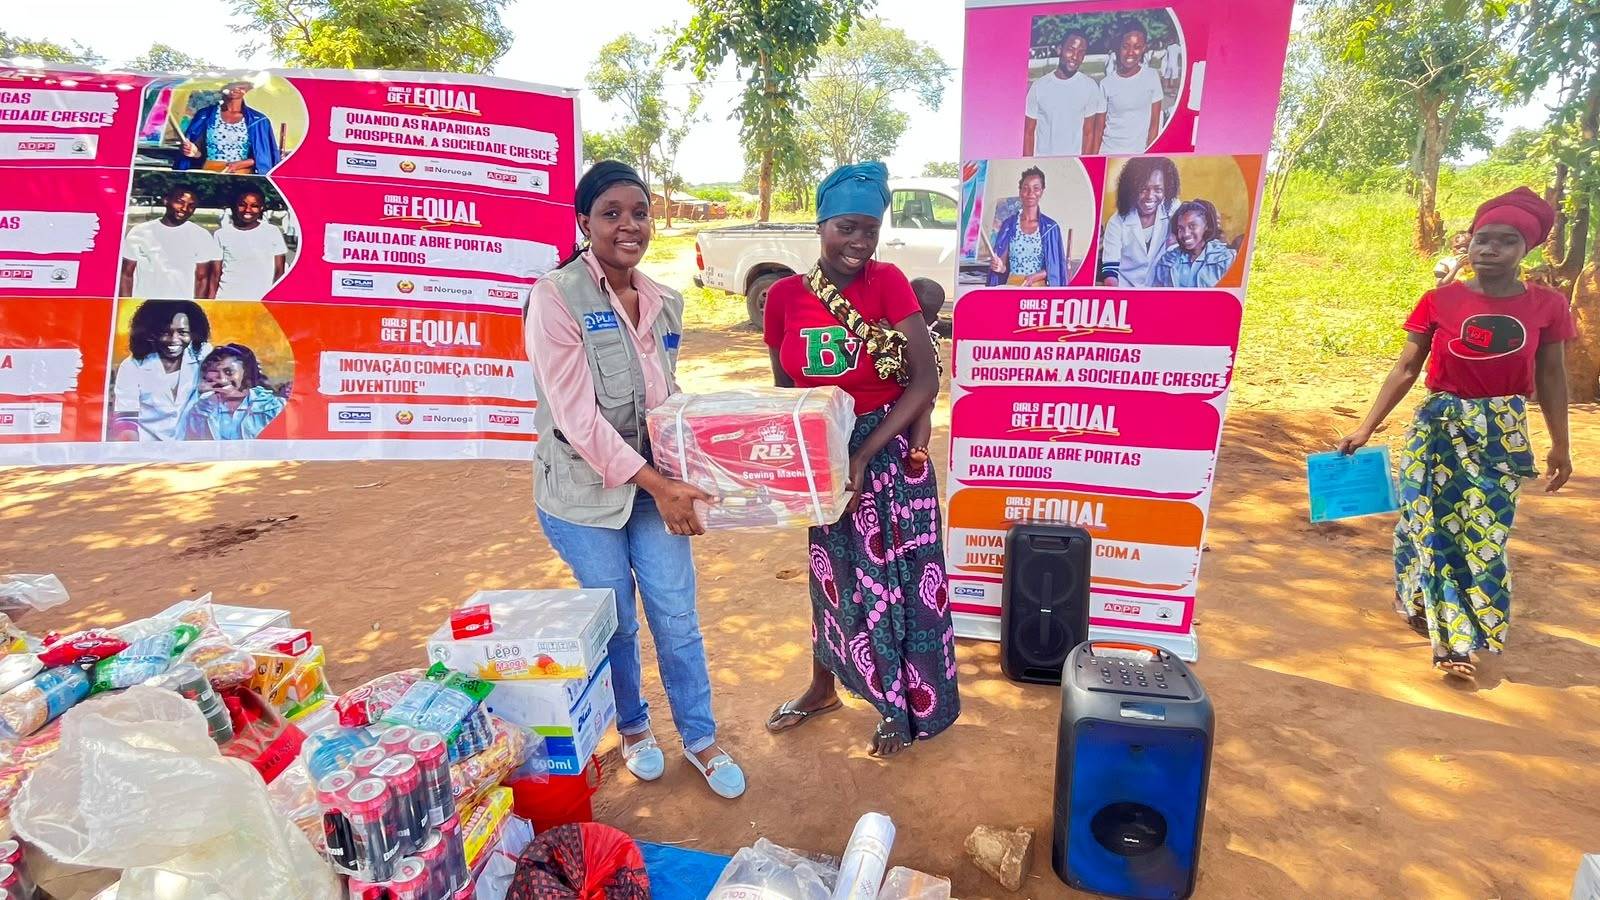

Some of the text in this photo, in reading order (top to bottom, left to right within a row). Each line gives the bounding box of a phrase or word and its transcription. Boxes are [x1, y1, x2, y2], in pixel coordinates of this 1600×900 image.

[0, 92, 31, 104] GAS
[387, 87, 480, 112] GET EQUAL
[51, 111, 106, 123] CRESCE
[346, 112, 490, 137] QUANDO AS RAPARIGAS
[18, 142, 55, 151] ADPP
[430, 137, 439, 147] A
[442, 138, 507, 155] SOCIEDADE
[509, 147, 552, 161] CRESCE
[435, 167, 472, 177] Noruega
[487, 171, 518, 182] ADPP
[384, 194, 408, 205] GIRLS
[383, 196, 480, 224] GET EQUAL
[343, 230, 502, 254] IGAULDADE ABRE PORTAS
[343, 248, 426, 265] PARA TODOS
[0, 269, 32, 278] DPP
[434, 286, 473, 295] Noruega
[488, 289, 518, 299] ADPP
[1019, 299, 1048, 310] GIRLS
[1018, 298, 1132, 332] GET EQUAL
[381, 317, 407, 328] GIRLS
[381, 319, 481, 347] GET EQUAL
[972, 346, 1141, 363] QUANDO AS RAPARIGAS
[1, 355, 13, 369] A
[339, 357, 514, 379] INOVAÇÃO COMEÇA COM A
[1065, 369, 1075, 382] A
[1078, 368, 1159, 386] SOCIEDADE
[1162, 373, 1221, 388] CRESCE
[1012, 402, 1039, 412] GIRLS
[433, 414, 473, 424] Noruega
[488, 414, 519, 424] ADPP
[1012, 402, 1119, 433] GET EQUAL
[750, 443, 796, 460] REX
[970, 445, 1141, 466] IGAULDADE ABRE PORTAS
[743, 469, 815, 480] Sewing Machi
[969, 465, 1052, 479] PARA TODOS
[1006, 496, 1031, 506] GIRLS
[1005, 497, 1107, 526] GET EQUAL
[966, 535, 1140, 560] INOVA COM A
[1104, 603, 1141, 614] ADPP
[496, 658, 527, 671] Mango
